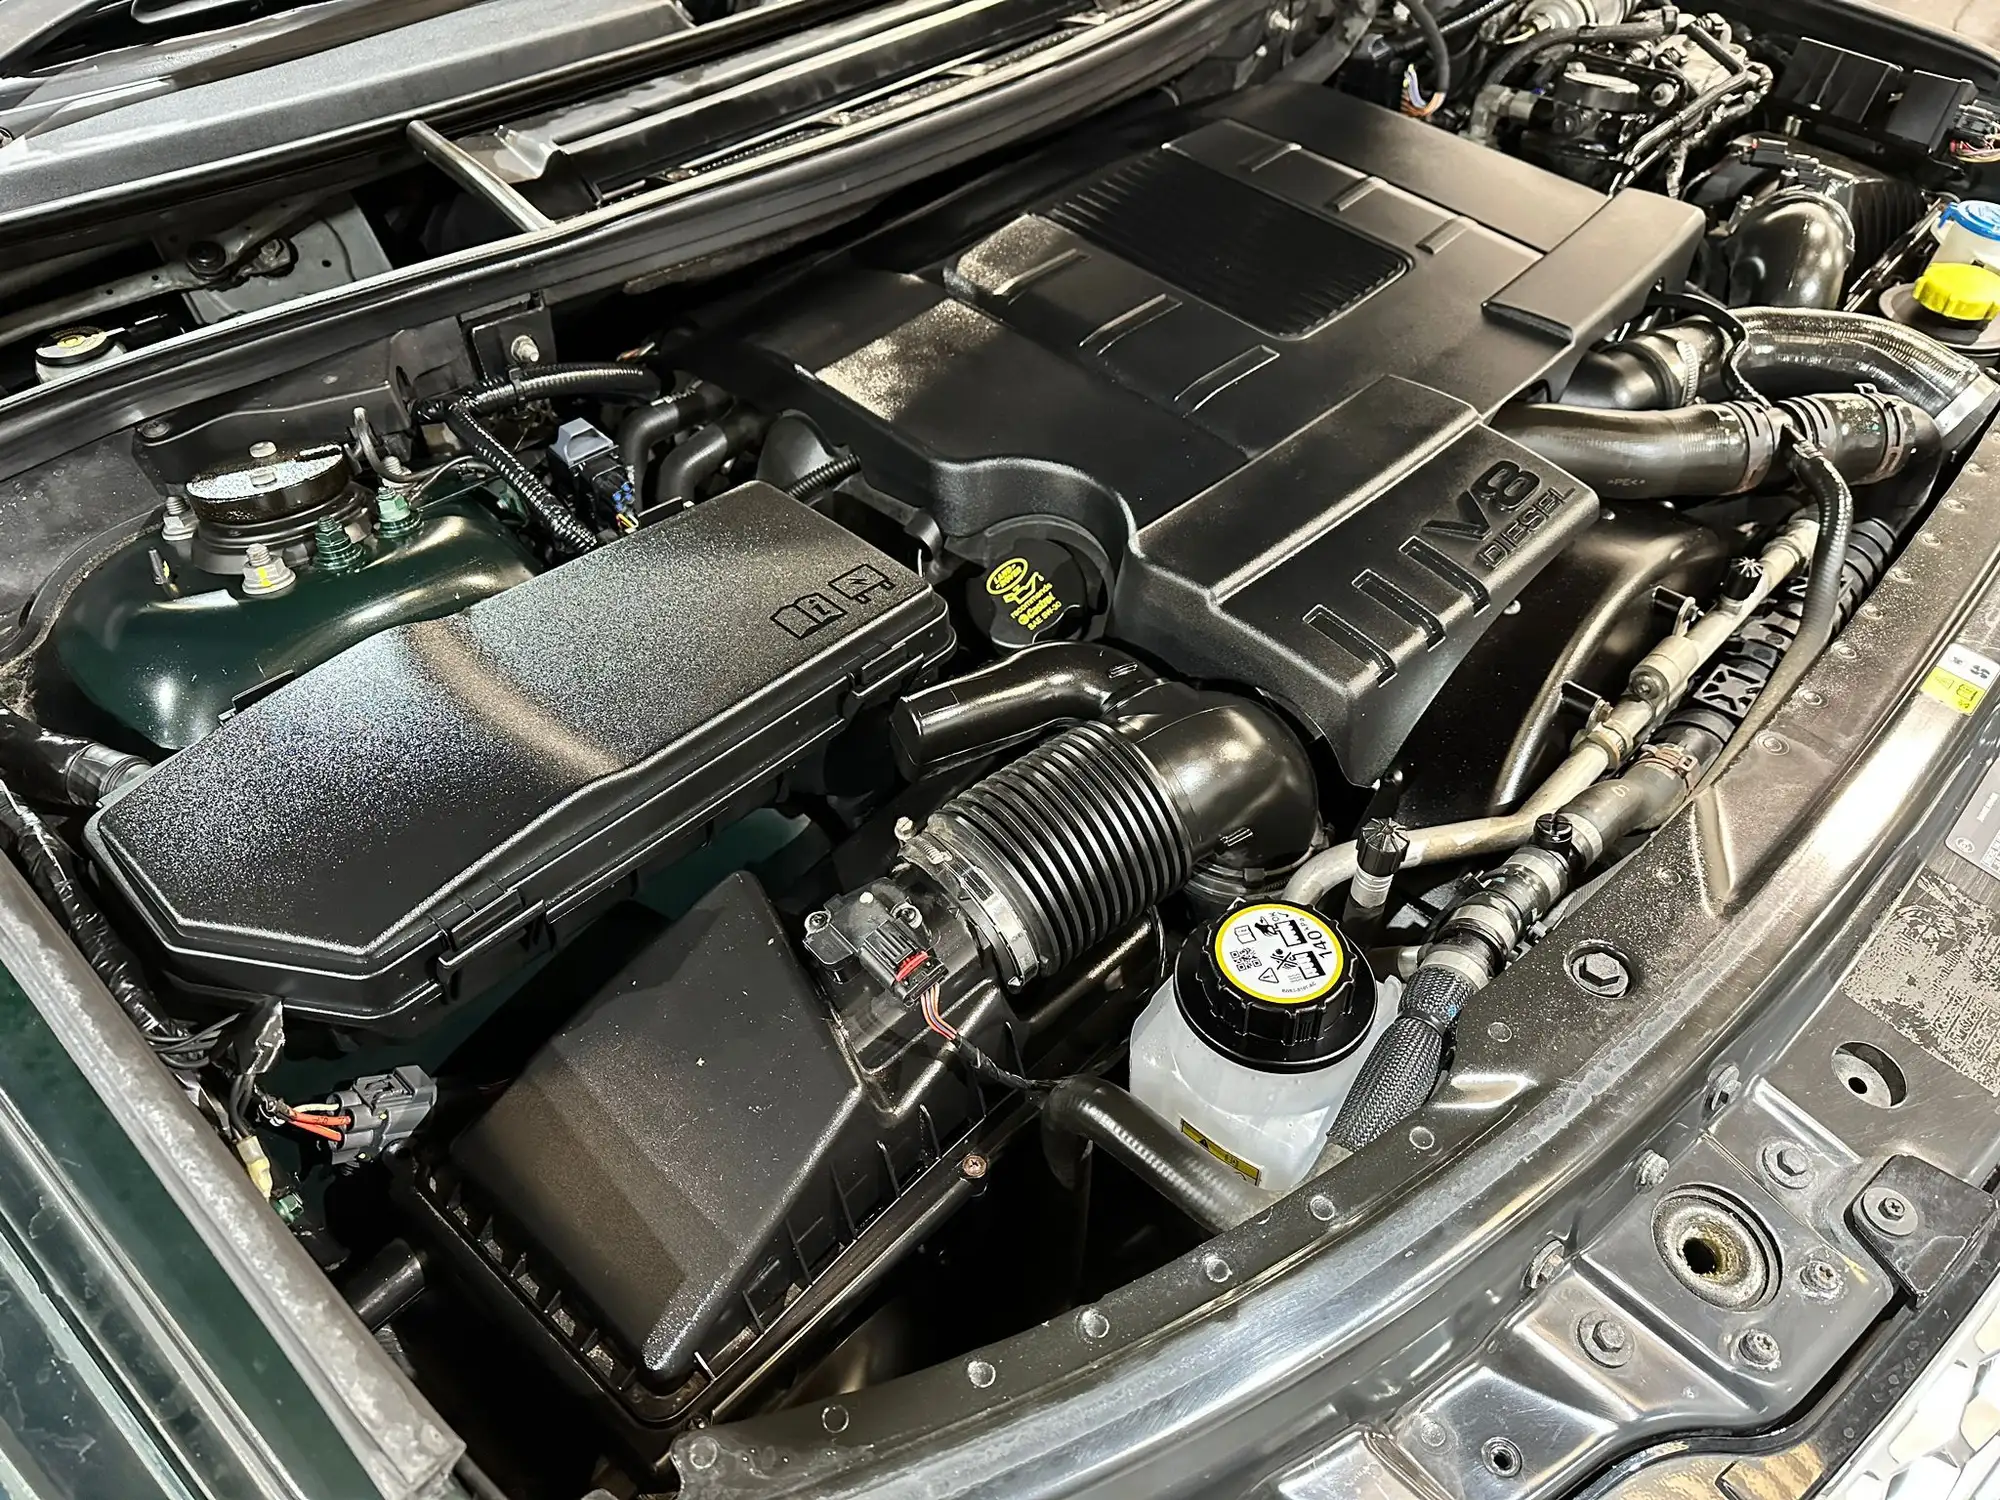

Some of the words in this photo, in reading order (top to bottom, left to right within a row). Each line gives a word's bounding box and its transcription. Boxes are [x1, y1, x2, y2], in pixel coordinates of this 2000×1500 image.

[1420, 460, 1542, 542] V8
[1477, 486, 1577, 570] DIESEL
[1010, 582, 1053, 619] recommends
[1026, 591, 1056, 620] Castrol
[1027, 615, 1044, 631] SAE
[1307, 930, 1333, 960] 140
